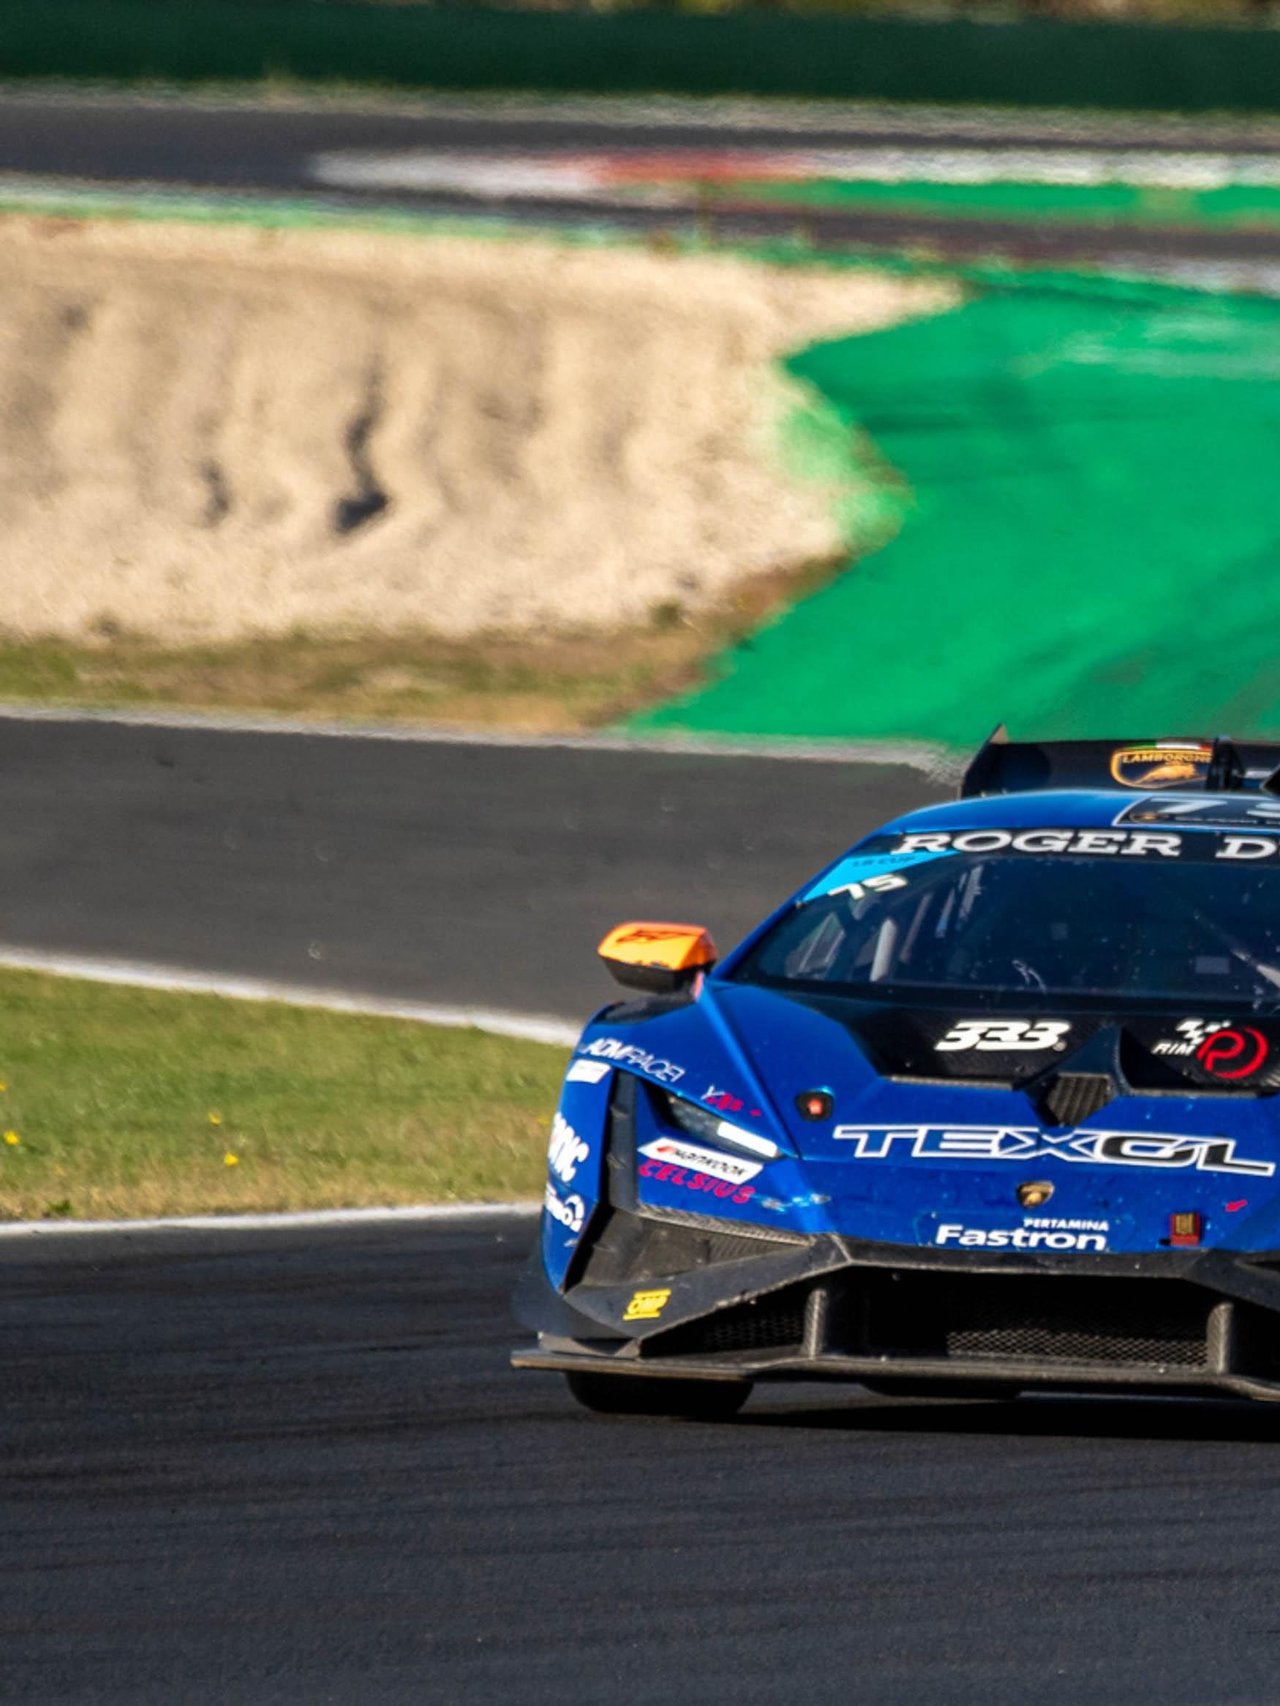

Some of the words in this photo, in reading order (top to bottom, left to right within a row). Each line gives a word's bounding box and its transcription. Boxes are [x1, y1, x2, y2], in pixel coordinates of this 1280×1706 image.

[890, 829, 1182, 857] ROGER
[933, 1018, 1071, 1052] 333
[638, 1159, 757, 1204] CELSIUS
[935, 1223, 1108, 1252] Fastron
[1022, 1216, 1110, 1232] PERTAMINA
[626, 1292, 670, 1316] OMP
